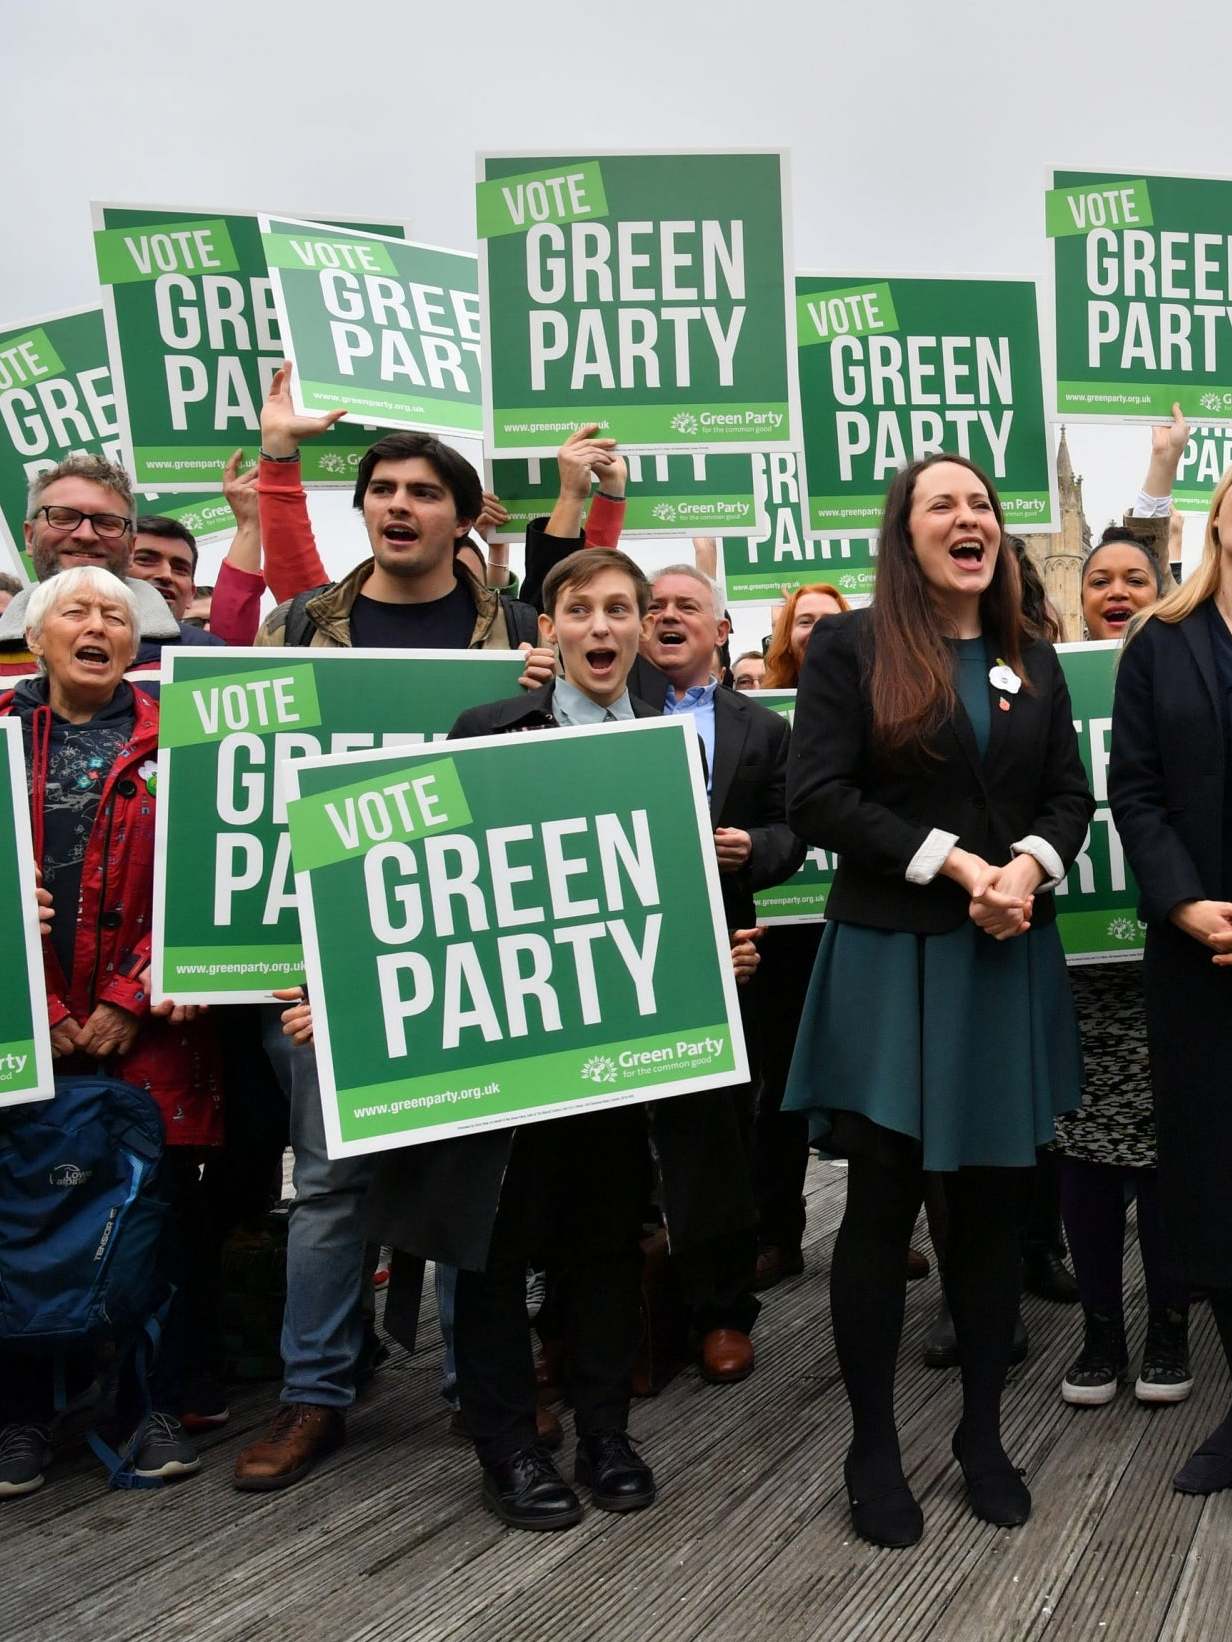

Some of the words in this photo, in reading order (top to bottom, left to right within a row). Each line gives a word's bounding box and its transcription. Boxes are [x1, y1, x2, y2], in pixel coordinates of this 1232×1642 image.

[502, 173, 591, 225] VOTE
[1067, 189, 1139, 229] VOTE
[124, 230, 221, 274] VOTE
[290, 240, 381, 272] VOTE
[526, 220, 746, 304] GREEN
[807, 293, 884, 337] VOTE
[529, 306, 746, 390] PARTY
[830, 335, 1013, 406] GREEN
[313, 391, 425, 413] www.greenparty.org.uk
[700, 412, 742, 425] Green
[745, 411, 783, 427] Party
[1065, 393, 1151, 404] www.greenparty.org.uk
[678, 502, 715, 514] Green
[717, 501, 750, 516] Party
[1016, 499, 1046, 512] Party
[192, 677, 300, 734] VOTE
[324, 775, 448, 850] VOTE
[364, 809, 661, 945] GREEN
[376, 912, 664, 1059] PARTY
[618, 1047, 674, 1068] Green
[676, 1037, 724, 1060] Party
[623, 1070, 636, 1078] for
[638, 1068, 652, 1076] the
[653, 1060, 690, 1073] common
[353, 1081, 501, 1118] www.greenparty.org.uk
